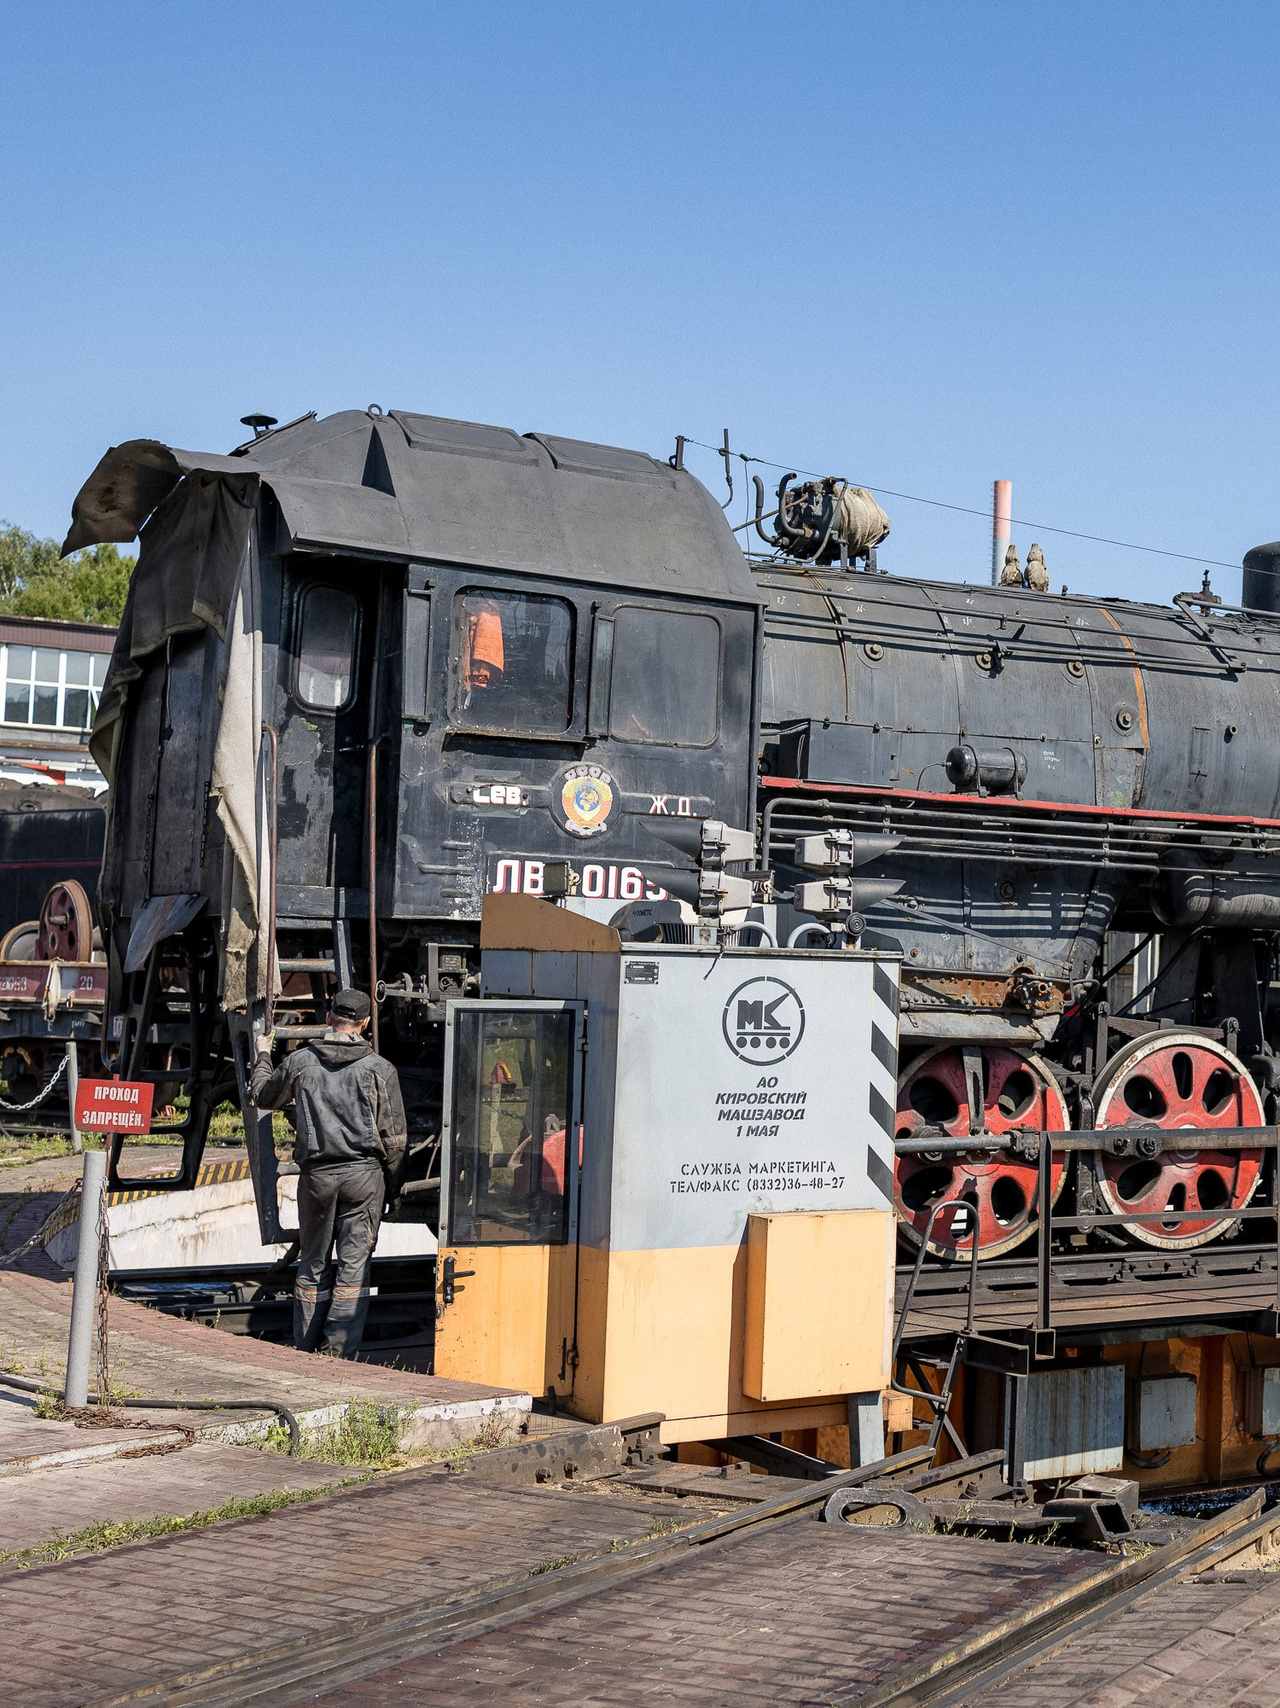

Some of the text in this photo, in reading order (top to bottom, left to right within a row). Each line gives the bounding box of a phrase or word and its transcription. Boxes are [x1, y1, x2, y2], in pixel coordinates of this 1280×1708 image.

[493, 859, 545, 896] ЛВ
[80, 976, 93, 990] 20
[756, 1076, 778, 1088] АО
[93, 1086, 139, 1104] ПРОХОД
[715, 1091, 807, 1104] КИРОВСКИЙ
[82, 1110, 145, 1128] ЗАПРЕЩЁН.
[717, 1108, 806, 1121] МАШЗАВОД
[736, 1124, 780, 1137] 1 МАЯ
[681, 1160, 836, 1176] СЛУЖБА МАРКЕТИНГА
[670, 1176, 845, 1193] ТЕЛ/ФАКС (8332)36-48-27
